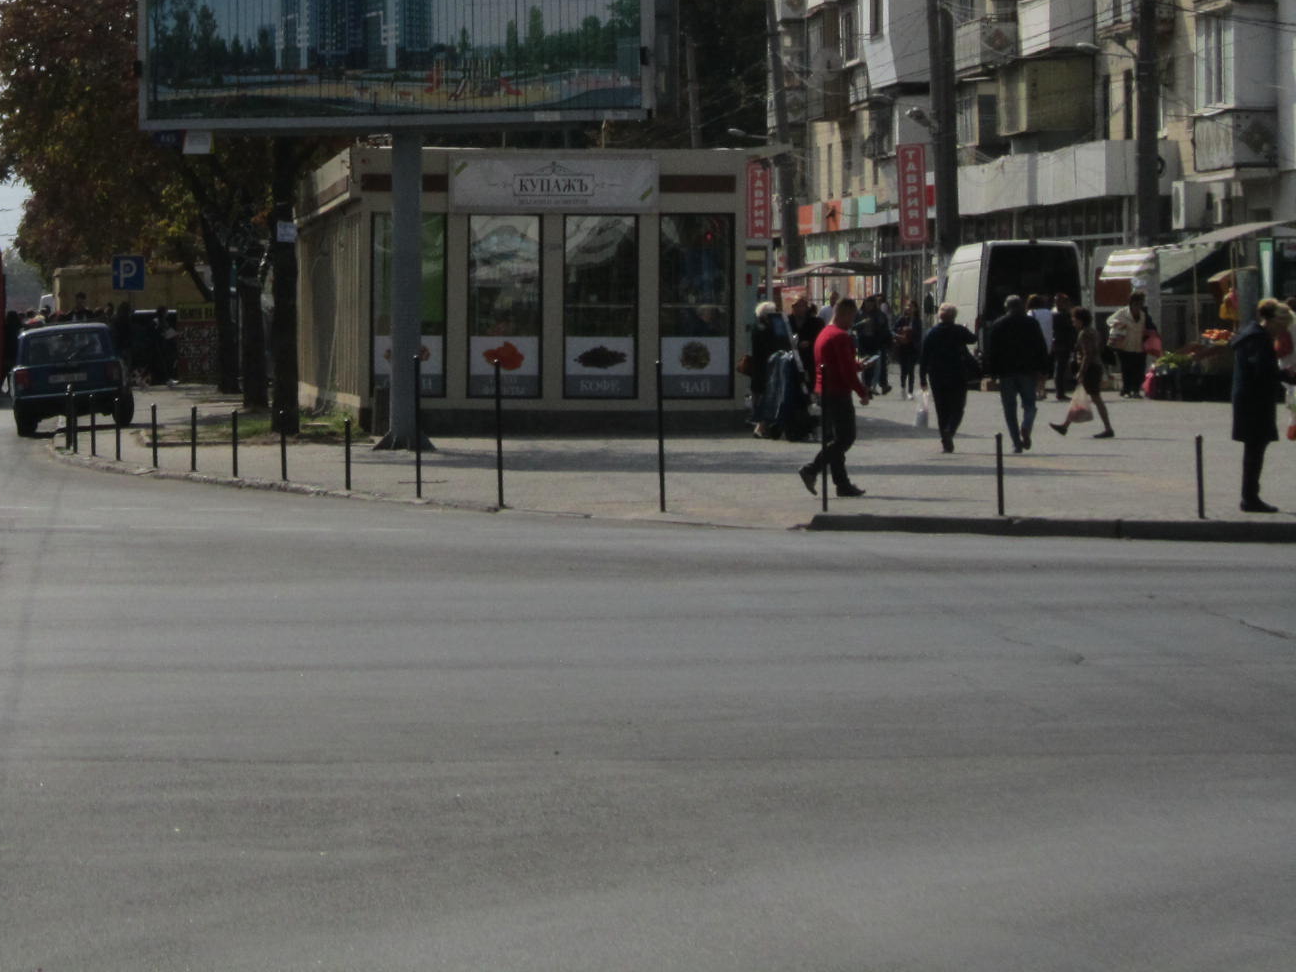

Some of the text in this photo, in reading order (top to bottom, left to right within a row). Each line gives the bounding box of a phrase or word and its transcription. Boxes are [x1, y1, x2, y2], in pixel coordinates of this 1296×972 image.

[518, 178, 589, 193] КУПАЖЪ
[905, 150, 920, 219] ТАВРИЯ
[753, 169, 766, 227] ТАВРИЯ
[579, 379, 621, 393] КОФЕ
[680, 379, 711, 393] ЧАЙ
